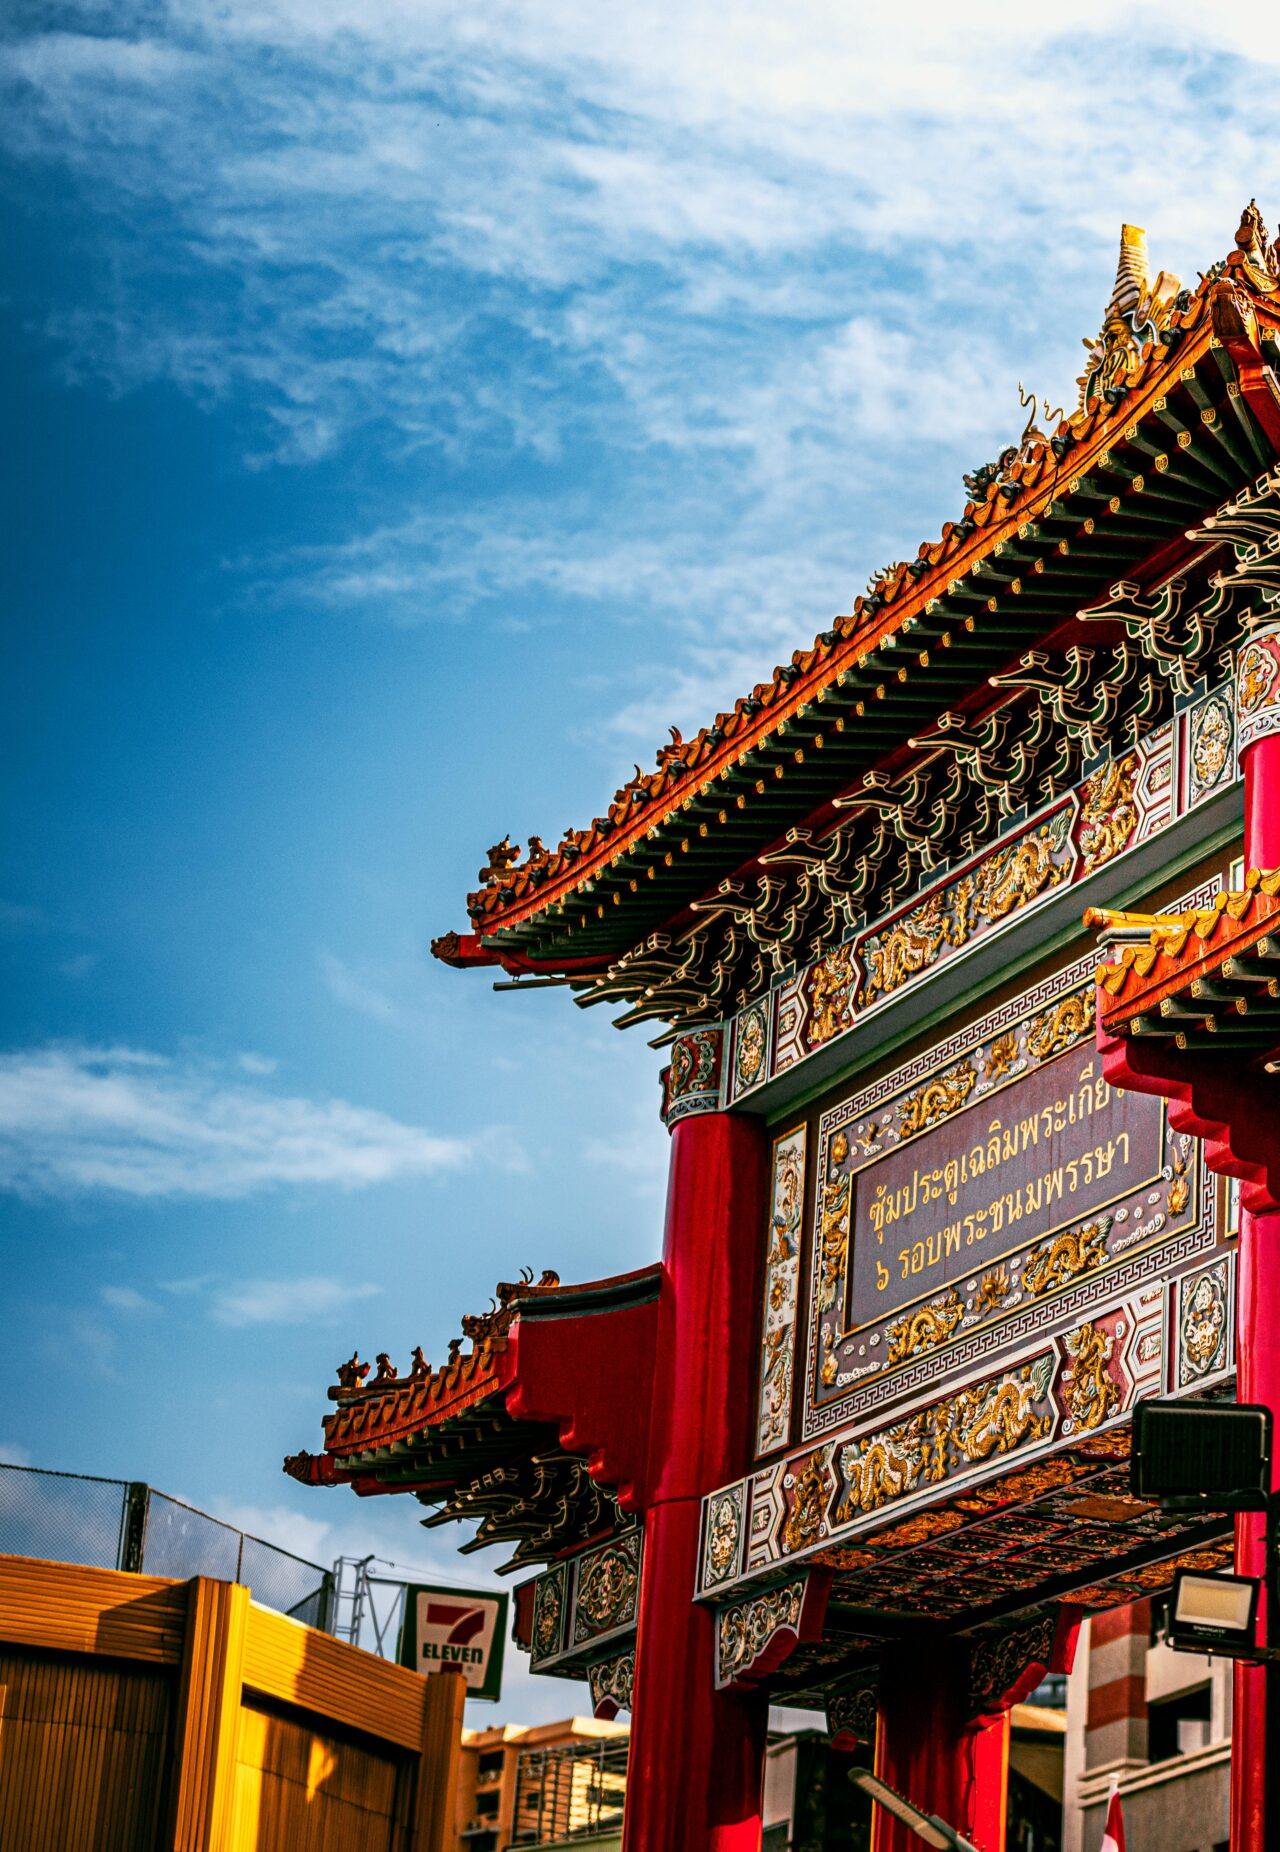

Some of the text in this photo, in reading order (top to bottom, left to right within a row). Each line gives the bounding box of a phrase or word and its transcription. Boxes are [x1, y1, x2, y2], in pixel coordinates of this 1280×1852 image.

[869, 1061, 1125, 1245] ซุ้มประตูเฉลิมพระเกีย
[876, 1132, 1129, 1291] ๖ รอบพระชนมพรรษา
[426, 1603, 486, 1674] 7
